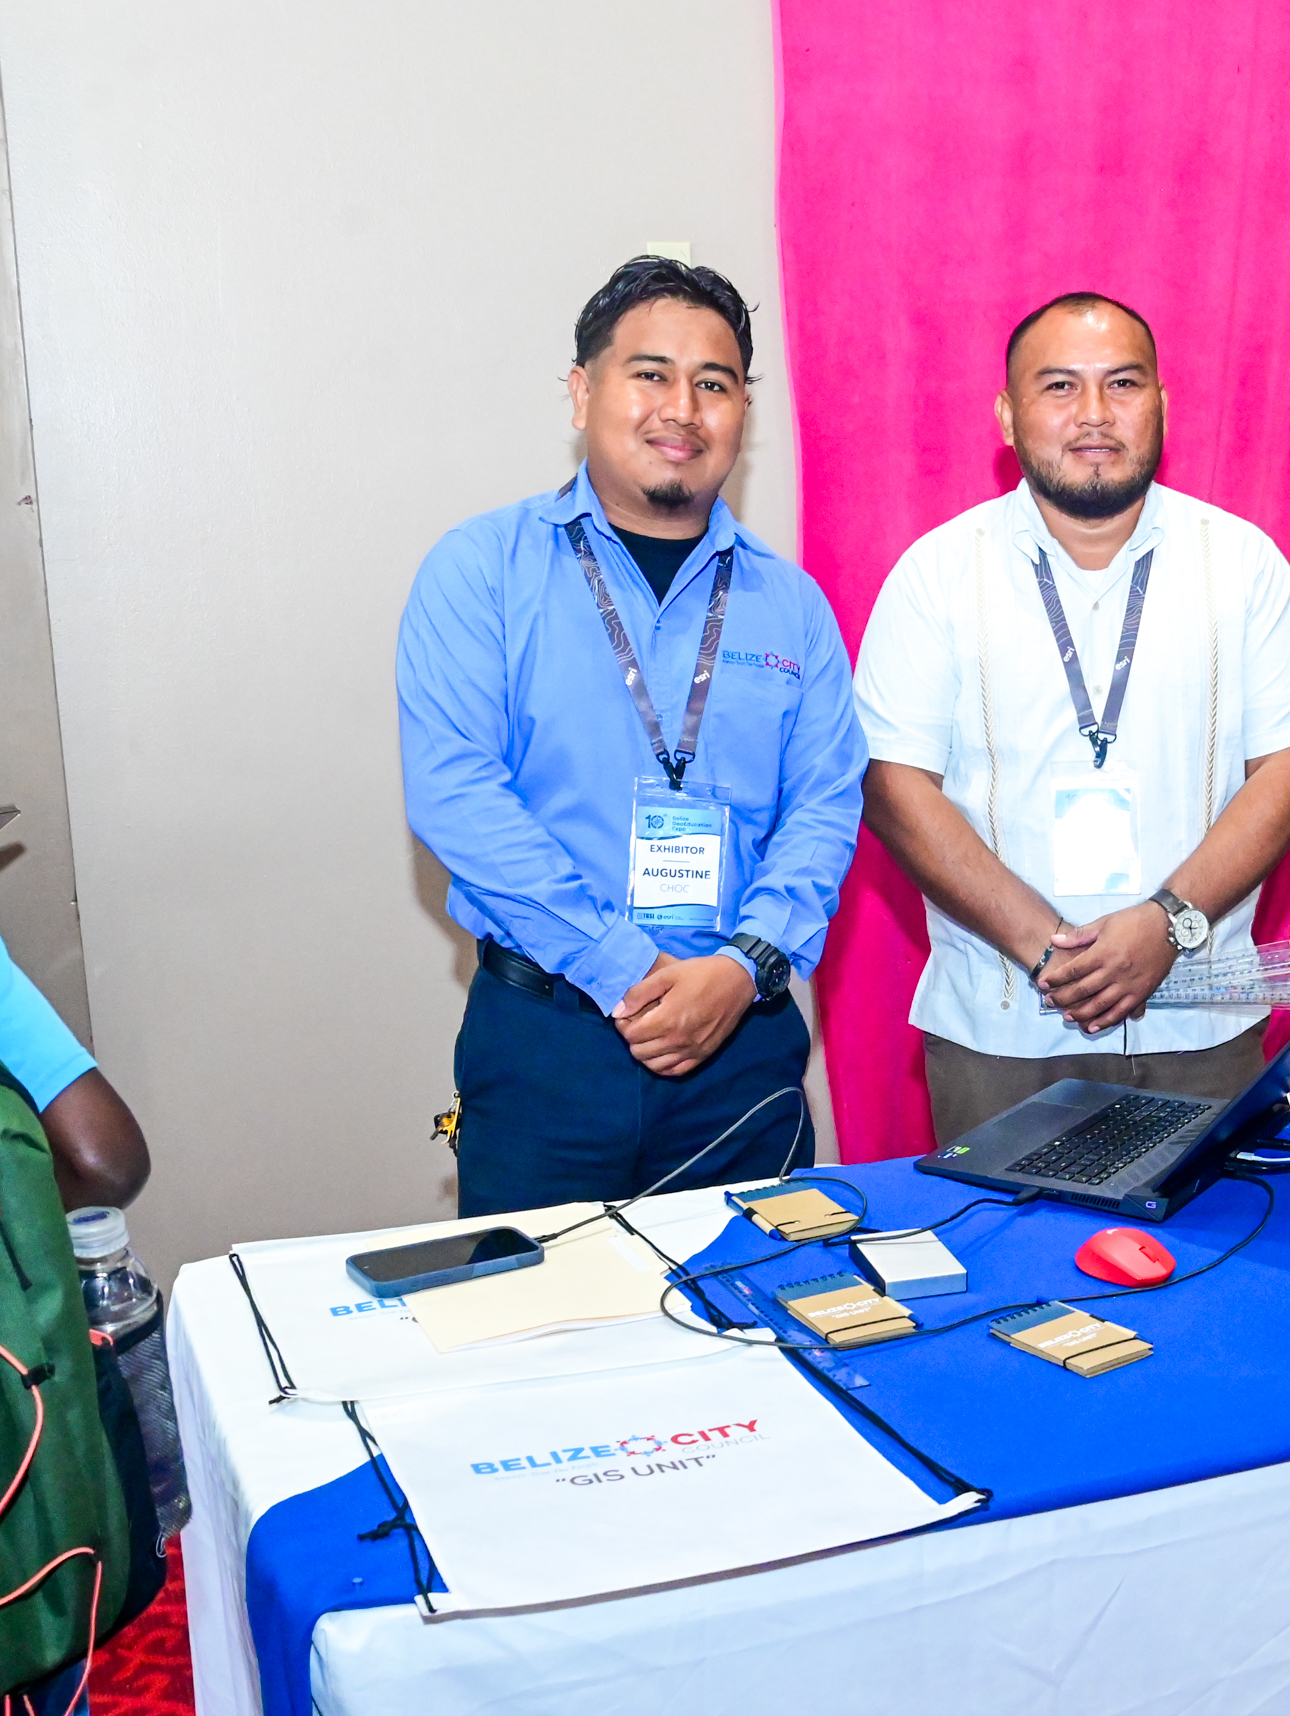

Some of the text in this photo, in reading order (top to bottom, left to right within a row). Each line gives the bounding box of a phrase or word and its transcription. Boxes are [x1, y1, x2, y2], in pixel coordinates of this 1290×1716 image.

[722, 650, 762, 662] BELIZE
[1063, 646, 1075, 662] esri
[1115, 656, 1131, 670] esri
[625, 667, 638, 686] esri
[694, 670, 710, 684] esri
[650, 844, 705, 855] EXHIBITOR
[642, 867, 711, 880] AUGUSTINE
[660, 883, 690, 893] CHOC
[470, 1419, 758, 1475] BELIZE CITY
[681, 1433, 771, 1454] COUNCIL
